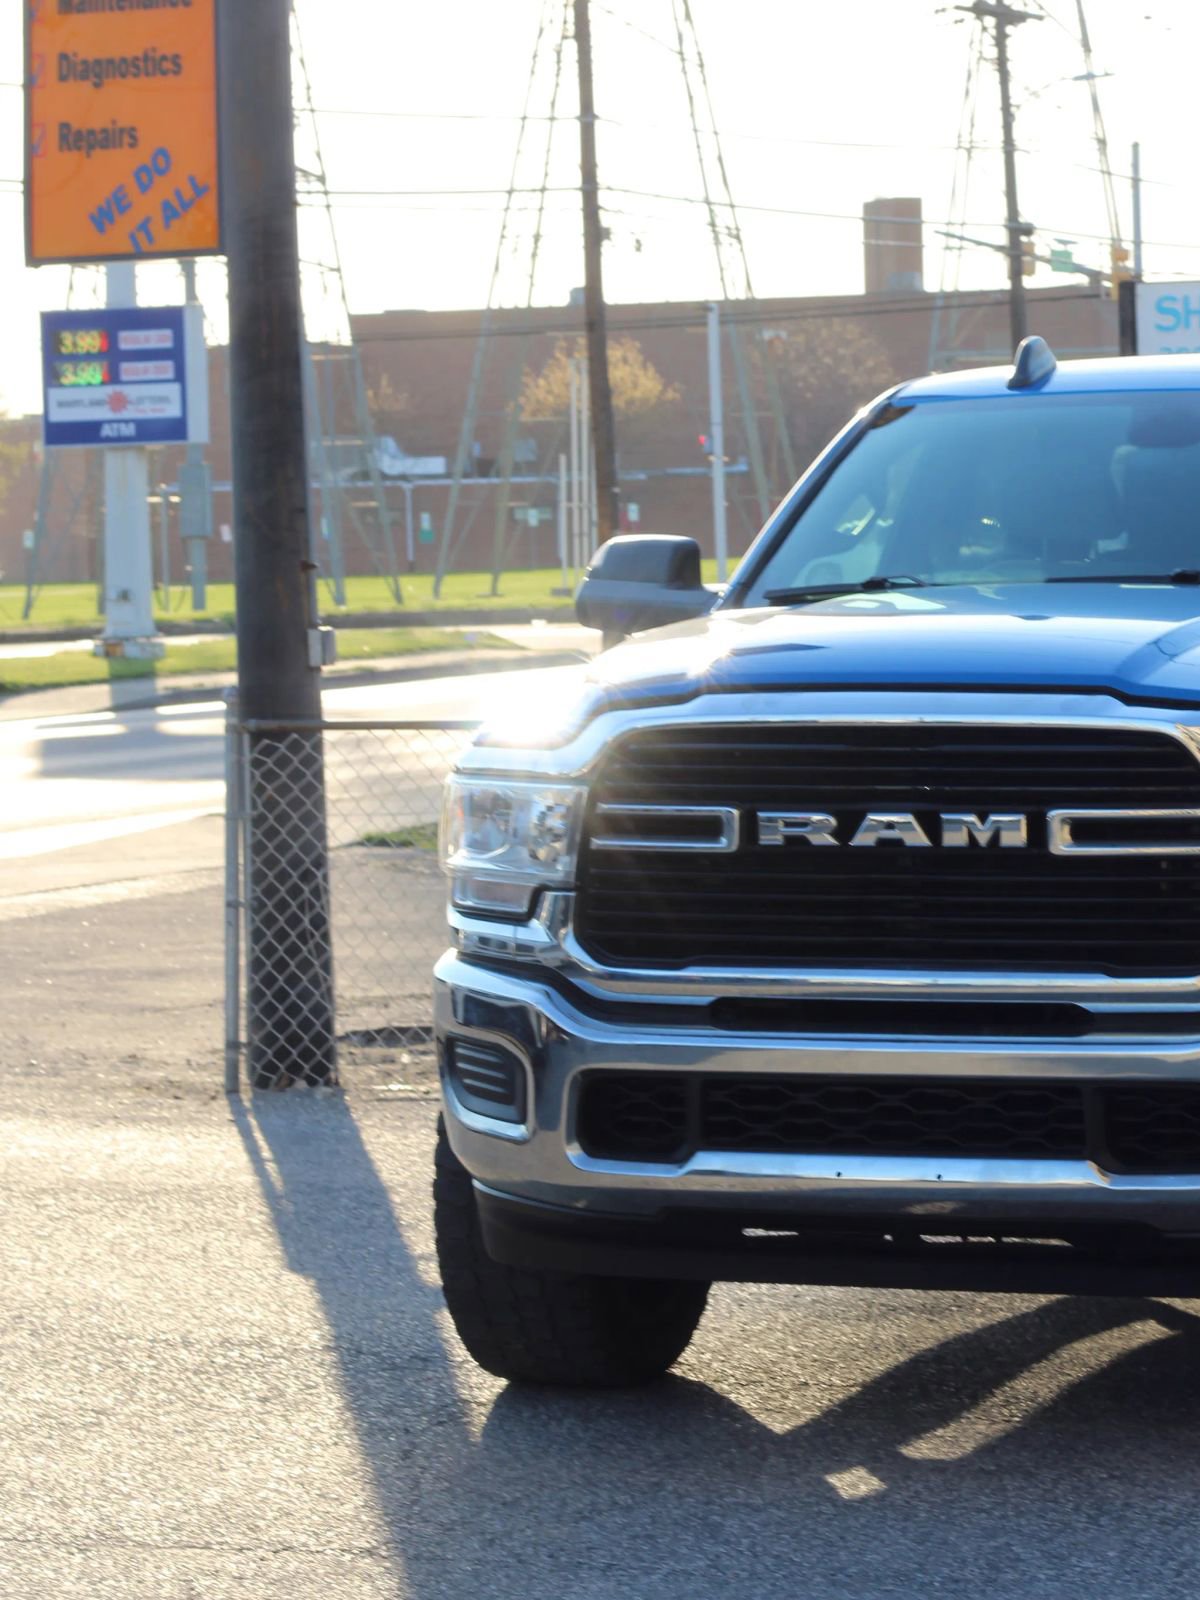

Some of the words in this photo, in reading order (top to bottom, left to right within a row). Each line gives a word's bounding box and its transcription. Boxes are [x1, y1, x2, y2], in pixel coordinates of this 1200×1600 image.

[58, 48, 182, 88] Diagnostics
[58, 120, 138, 158] Repairs
[89, 184, 132, 235] WE
[133, 147, 172, 194] DO
[128, 216, 155, 254] IT
[159, 174, 210, 230] ALL
[100, 422, 136, 437] ATM
[757, 811, 1028, 847] RAM
